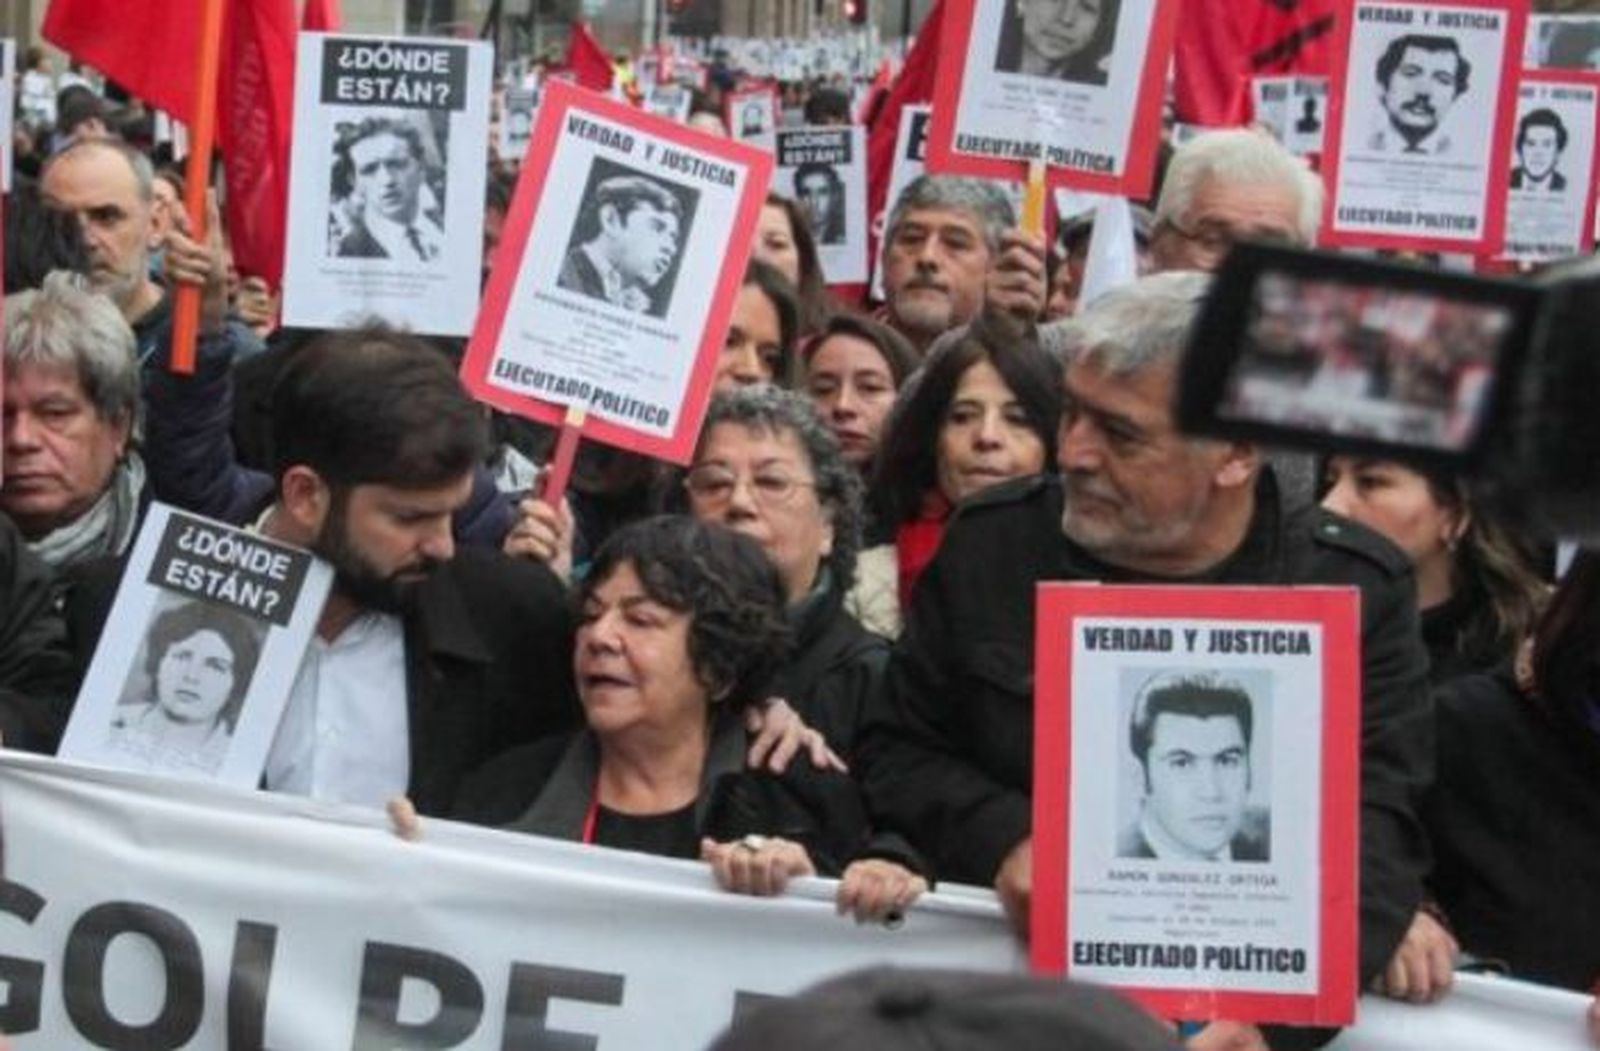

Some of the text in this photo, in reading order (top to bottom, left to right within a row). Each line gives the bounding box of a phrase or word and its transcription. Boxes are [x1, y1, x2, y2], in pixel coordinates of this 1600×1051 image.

[338, 44, 450, 74] ¿DÓNDE
[337, 76, 451, 105] ESTÁN?
[567, 115, 738, 189] VERDAD Y JUSTICIA
[494, 358, 670, 428] EJECUTADO POLÍTICO
[178, 526, 292, 581] ¿DÓNDE
[166, 559, 280, 615] ESTÁN?
[1083, 626, 1311, 655] VERDAD Y JUSTICIA
[1073, 941, 1306, 973] EJECUTADO POLÍTICO
